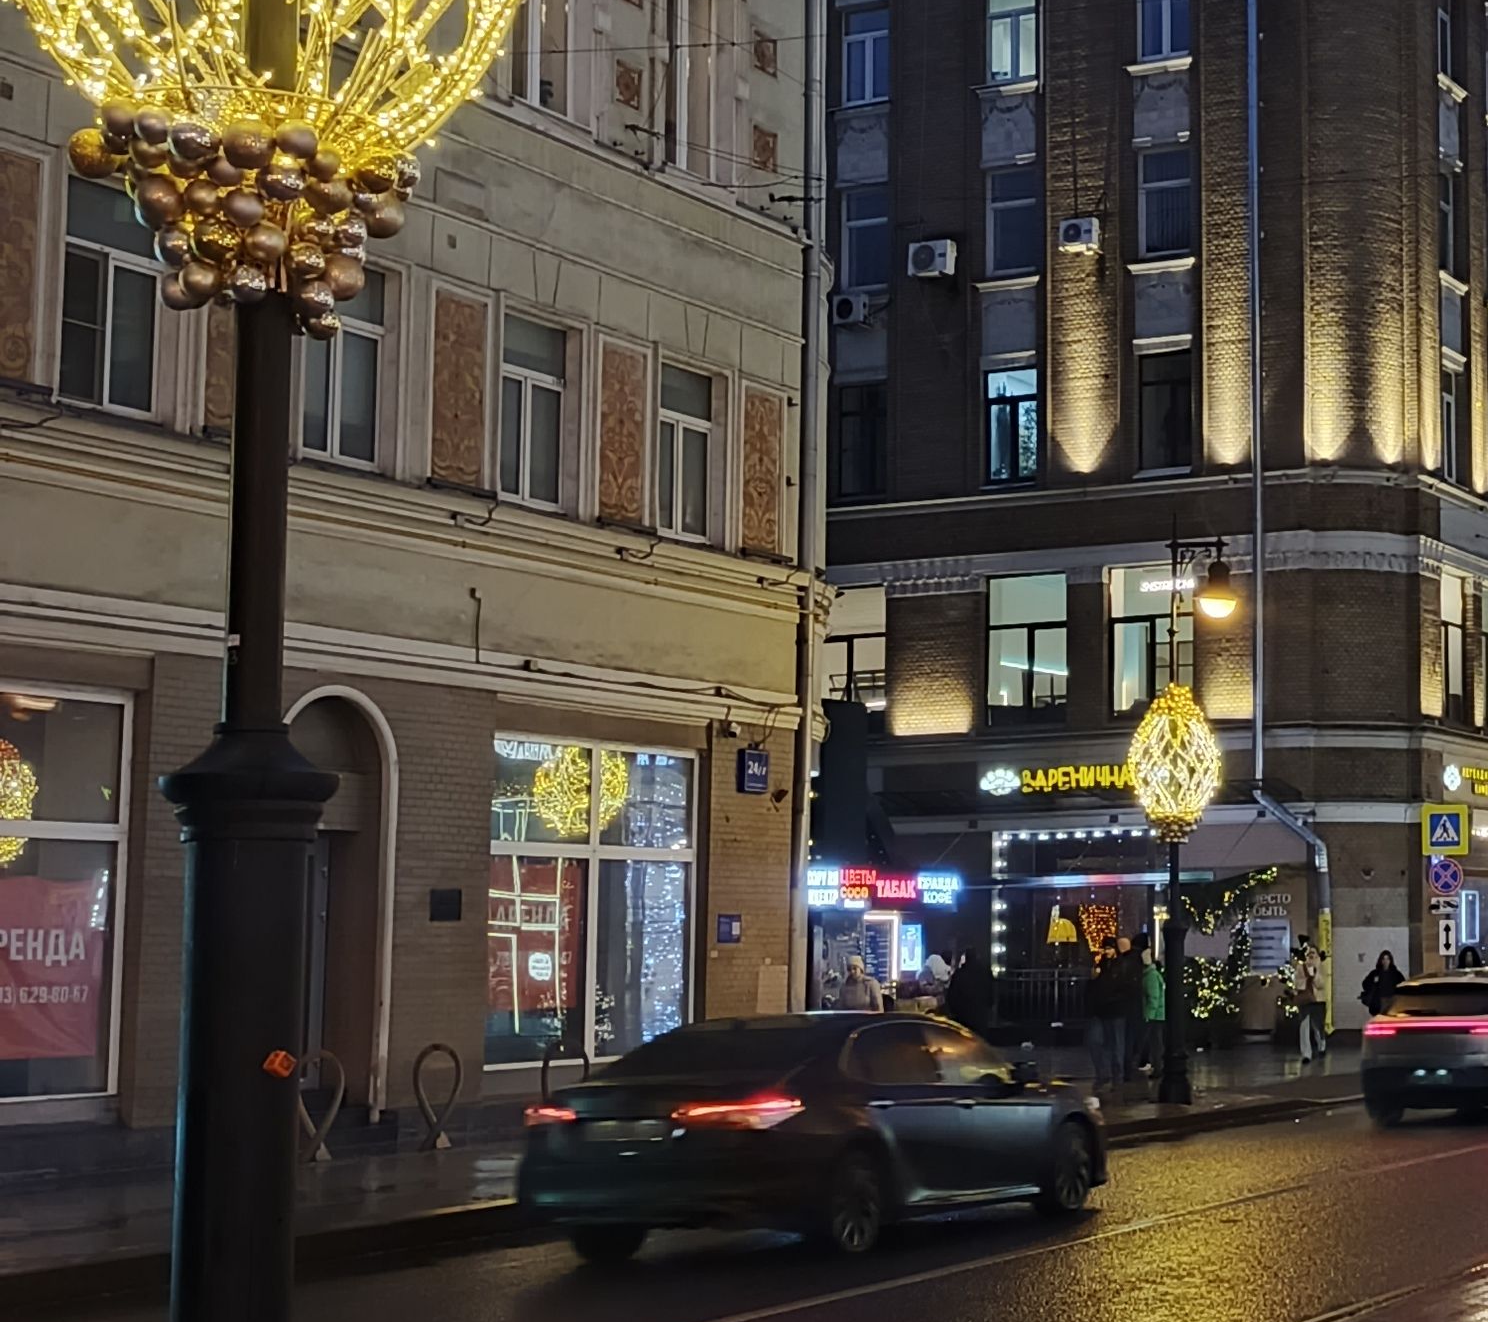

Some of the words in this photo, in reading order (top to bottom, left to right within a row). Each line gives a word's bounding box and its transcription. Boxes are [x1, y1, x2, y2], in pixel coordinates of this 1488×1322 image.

[1022, 763, 1138, 793] ВАРЕНИЧНА
[840, 868, 877, 886] ЦВЕТЫ
[876, 879, 917, 899] ТАБАК
[923, 890, 953, 904] КОФЕ
[1253, 903, 1288, 917] быть
